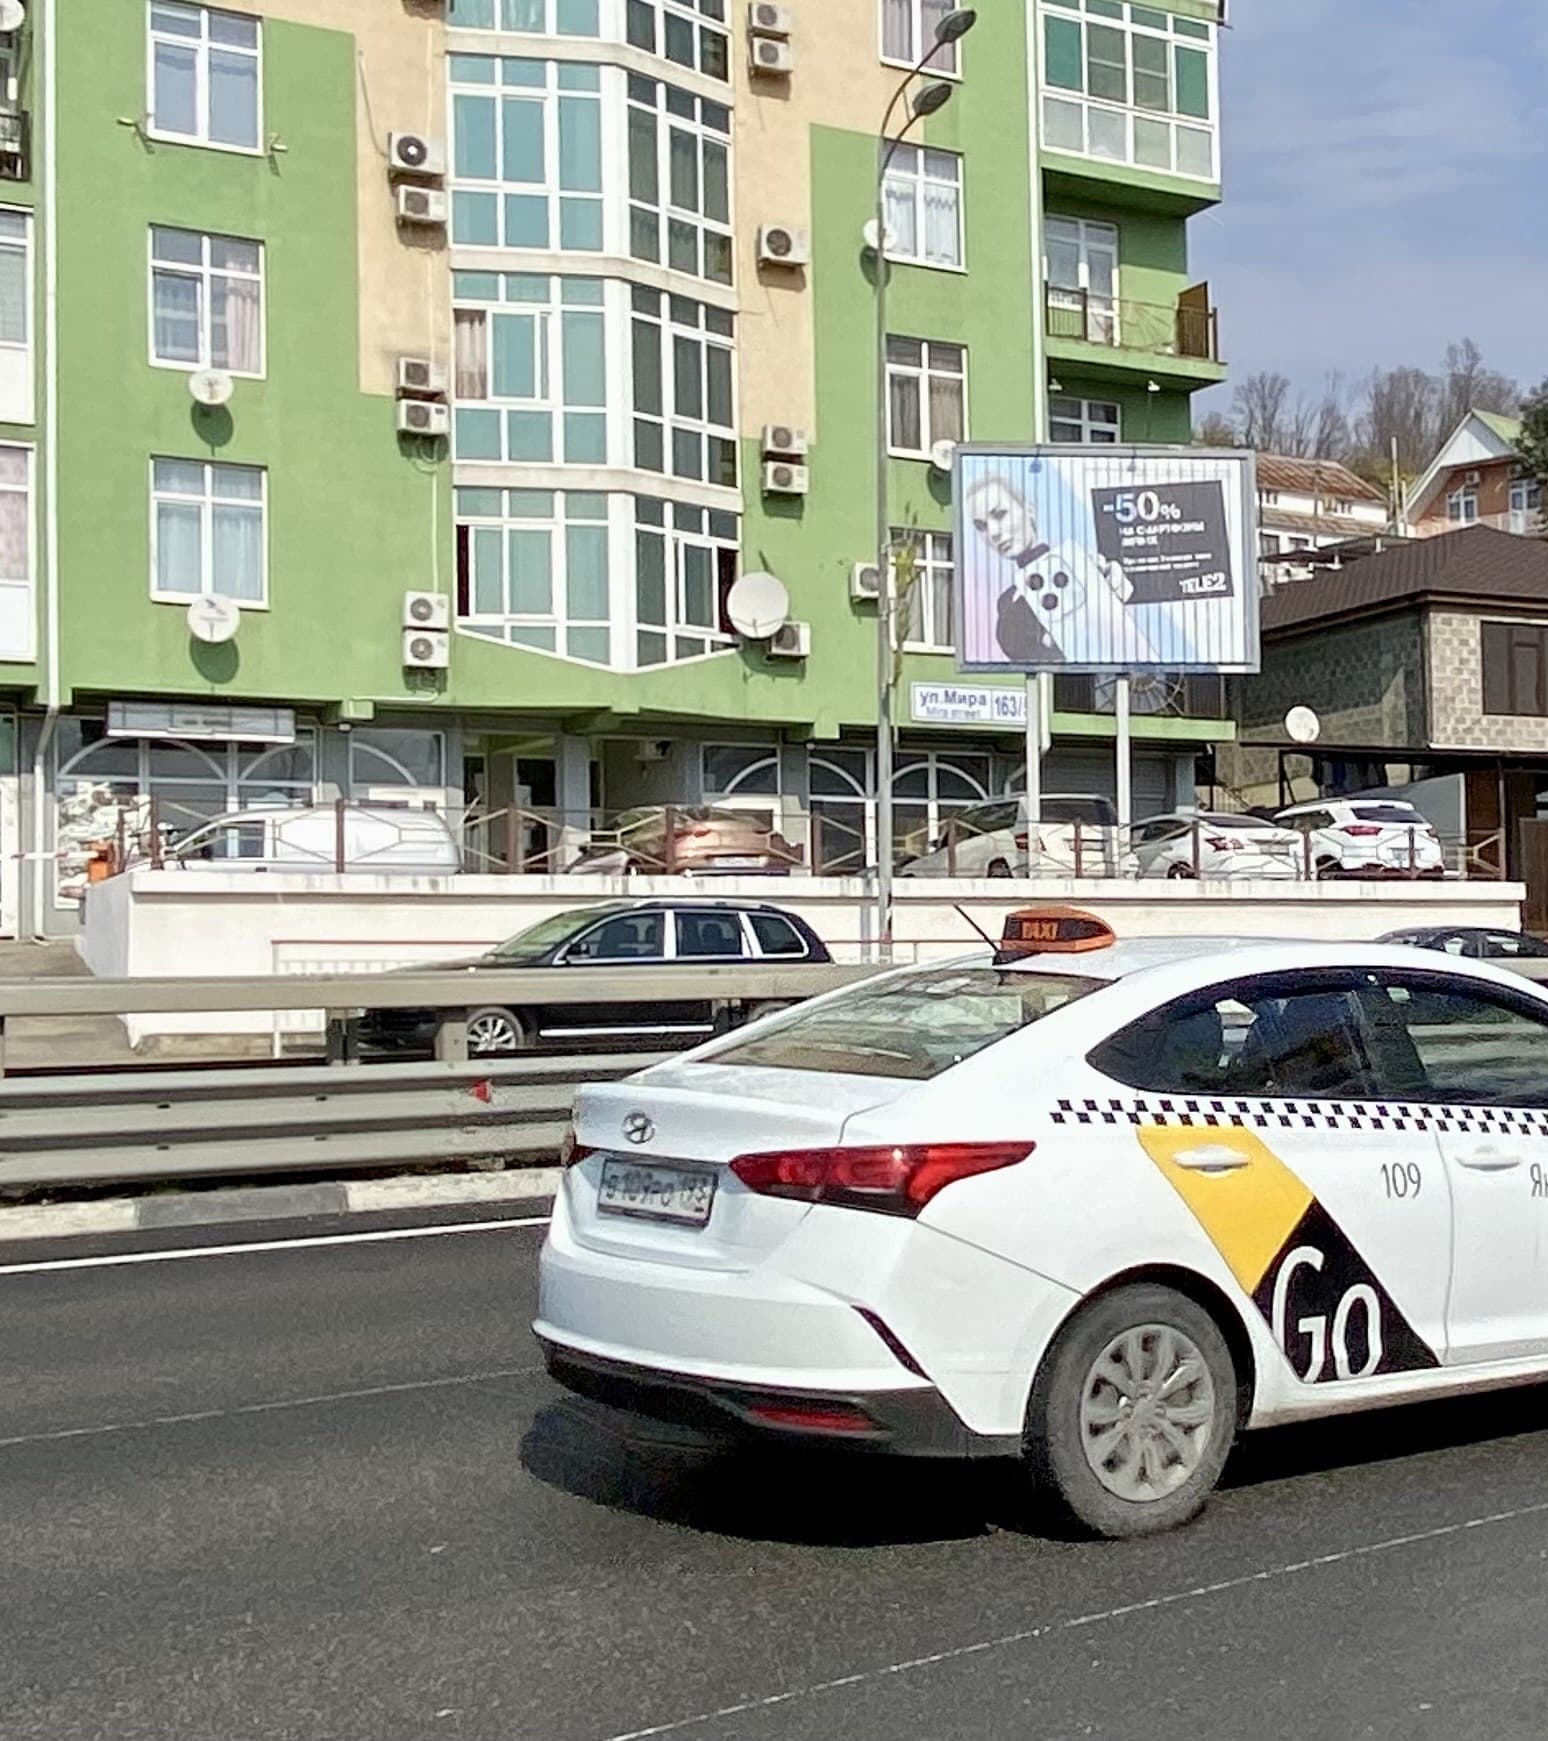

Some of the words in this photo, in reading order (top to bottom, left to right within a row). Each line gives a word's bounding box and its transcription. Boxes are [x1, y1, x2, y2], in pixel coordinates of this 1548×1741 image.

[1103, 490, 1181, 523] -50%
[1179, 572, 1228, 594] TELE2
[1022, 920, 1059, 940] TAXI
[1381, 1162, 1422, 1199] 109
